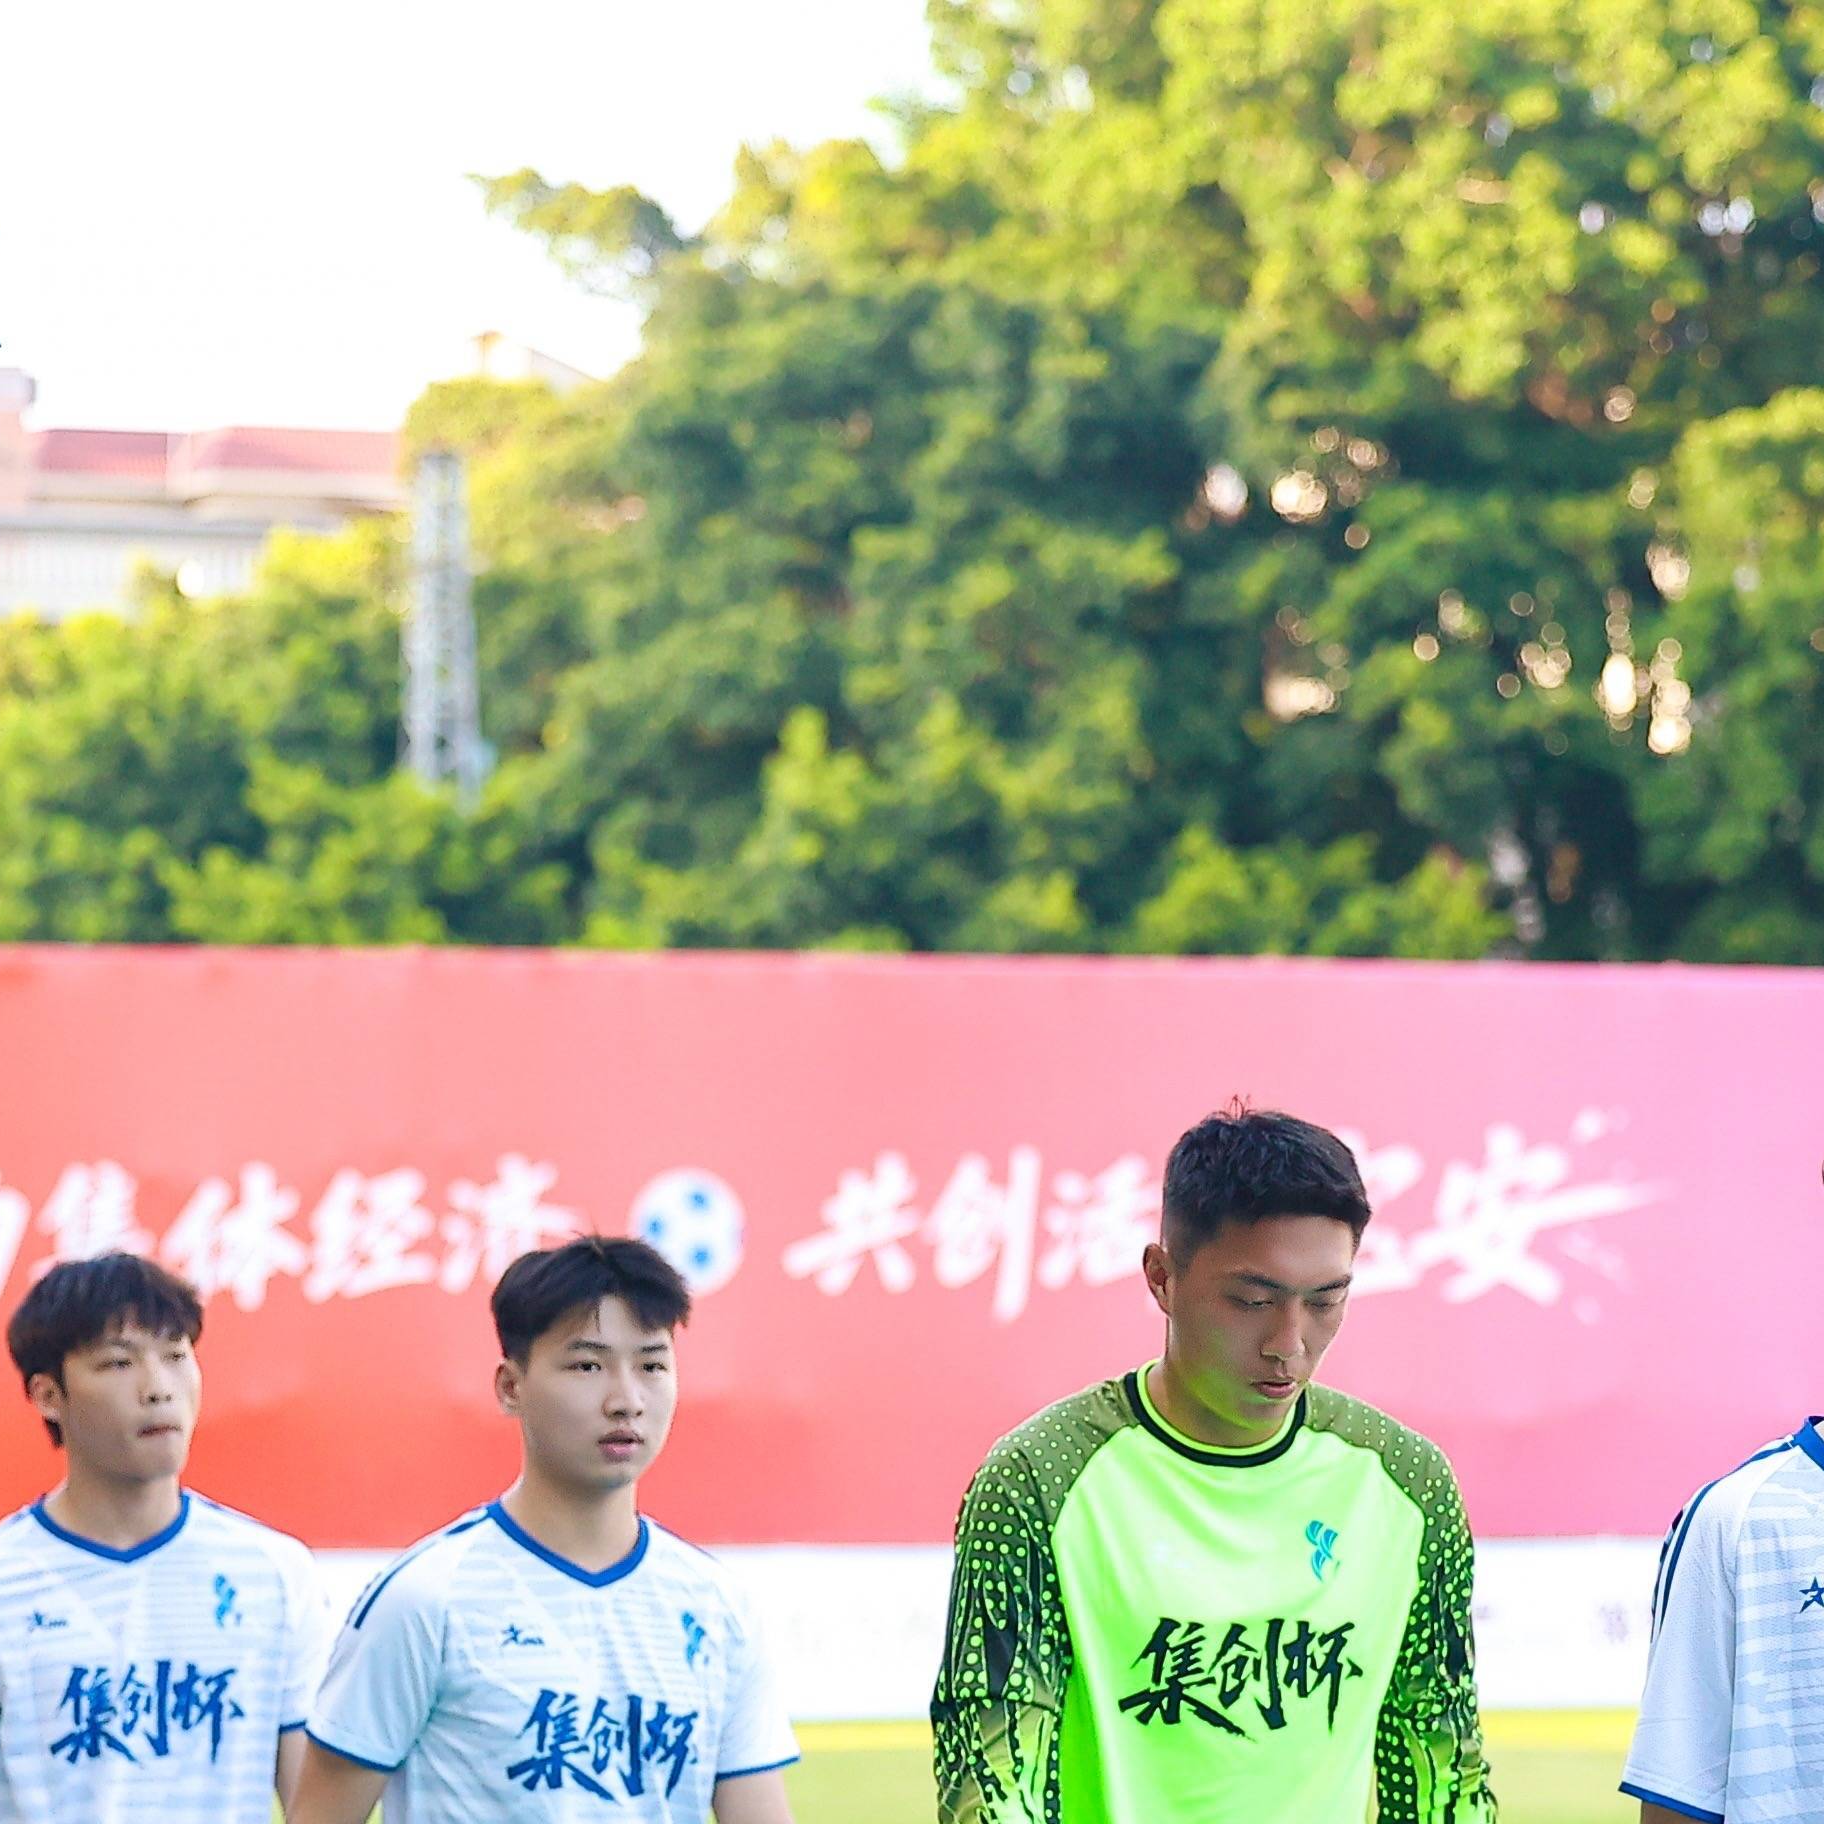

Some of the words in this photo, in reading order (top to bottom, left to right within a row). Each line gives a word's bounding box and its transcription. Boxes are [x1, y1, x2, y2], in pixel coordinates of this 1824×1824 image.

[50, 1659, 245, 1768] 集创杯
[1118, 1616, 1364, 1743] 集创杯
[507, 1688, 700, 1805] 集创杯
